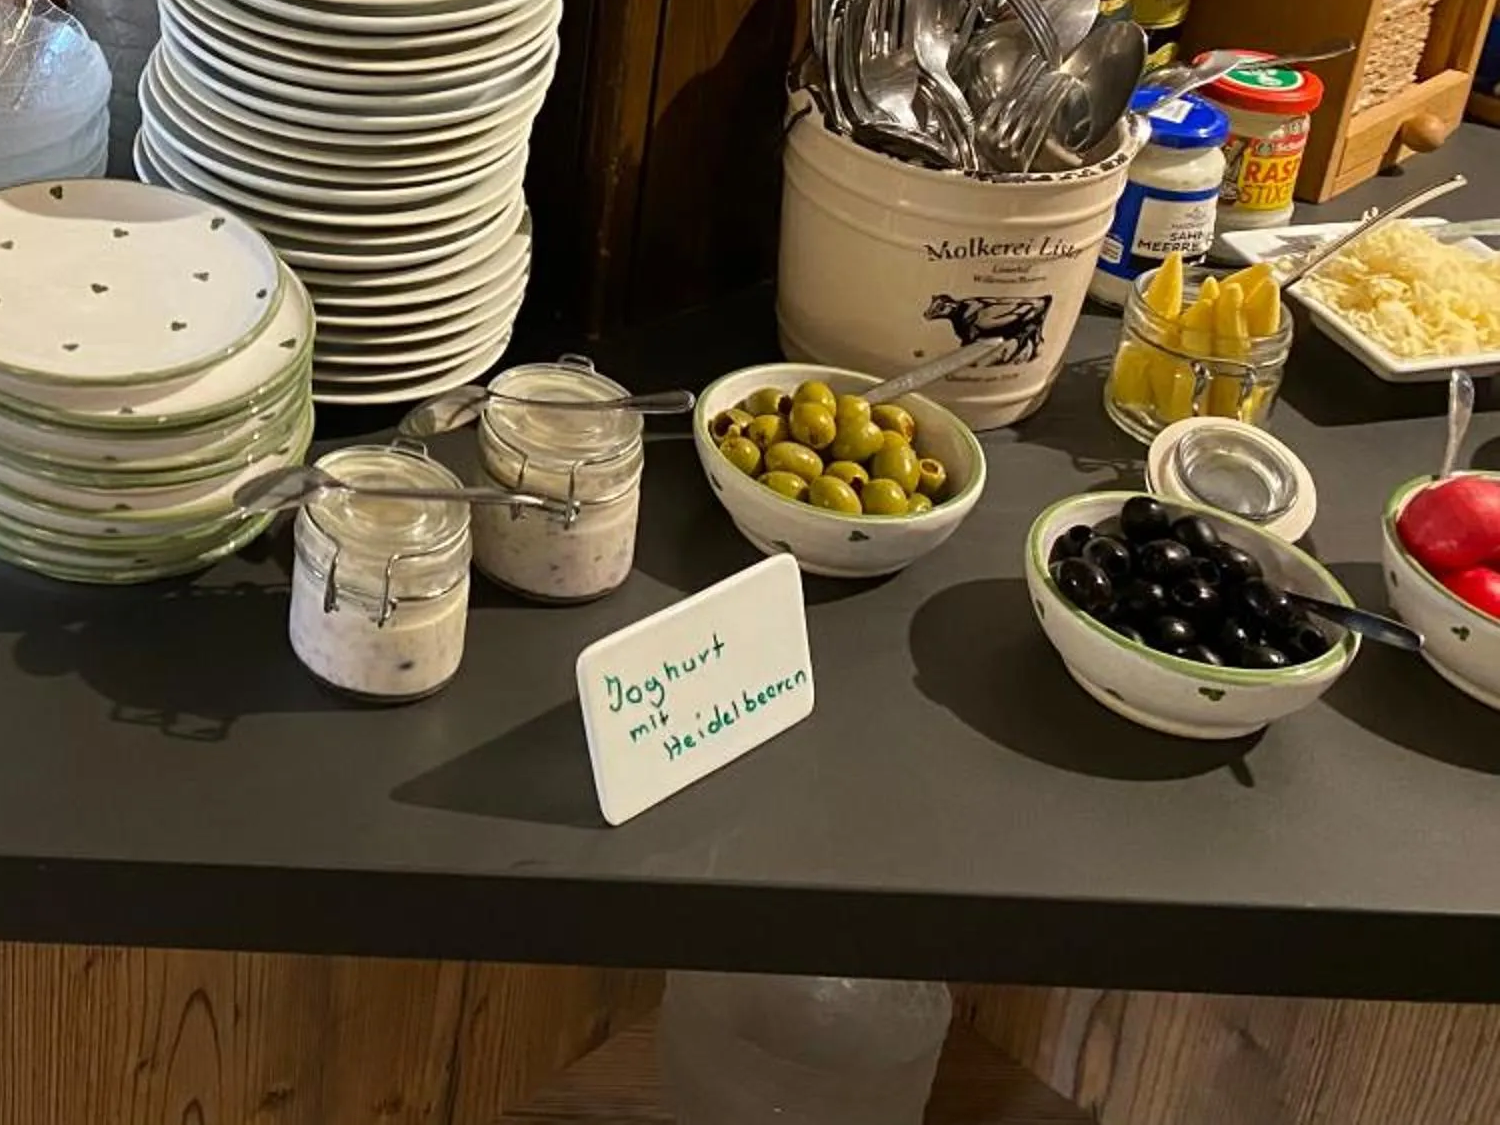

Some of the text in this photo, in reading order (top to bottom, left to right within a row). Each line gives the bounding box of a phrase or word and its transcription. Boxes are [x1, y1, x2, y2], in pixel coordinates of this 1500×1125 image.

[923, 236, 1033, 262] Molkerei
[603, 632, 726, 713] Joghurt
[628, 710, 671, 744] mit
[663, 668, 808, 761] Heidelbeeren
